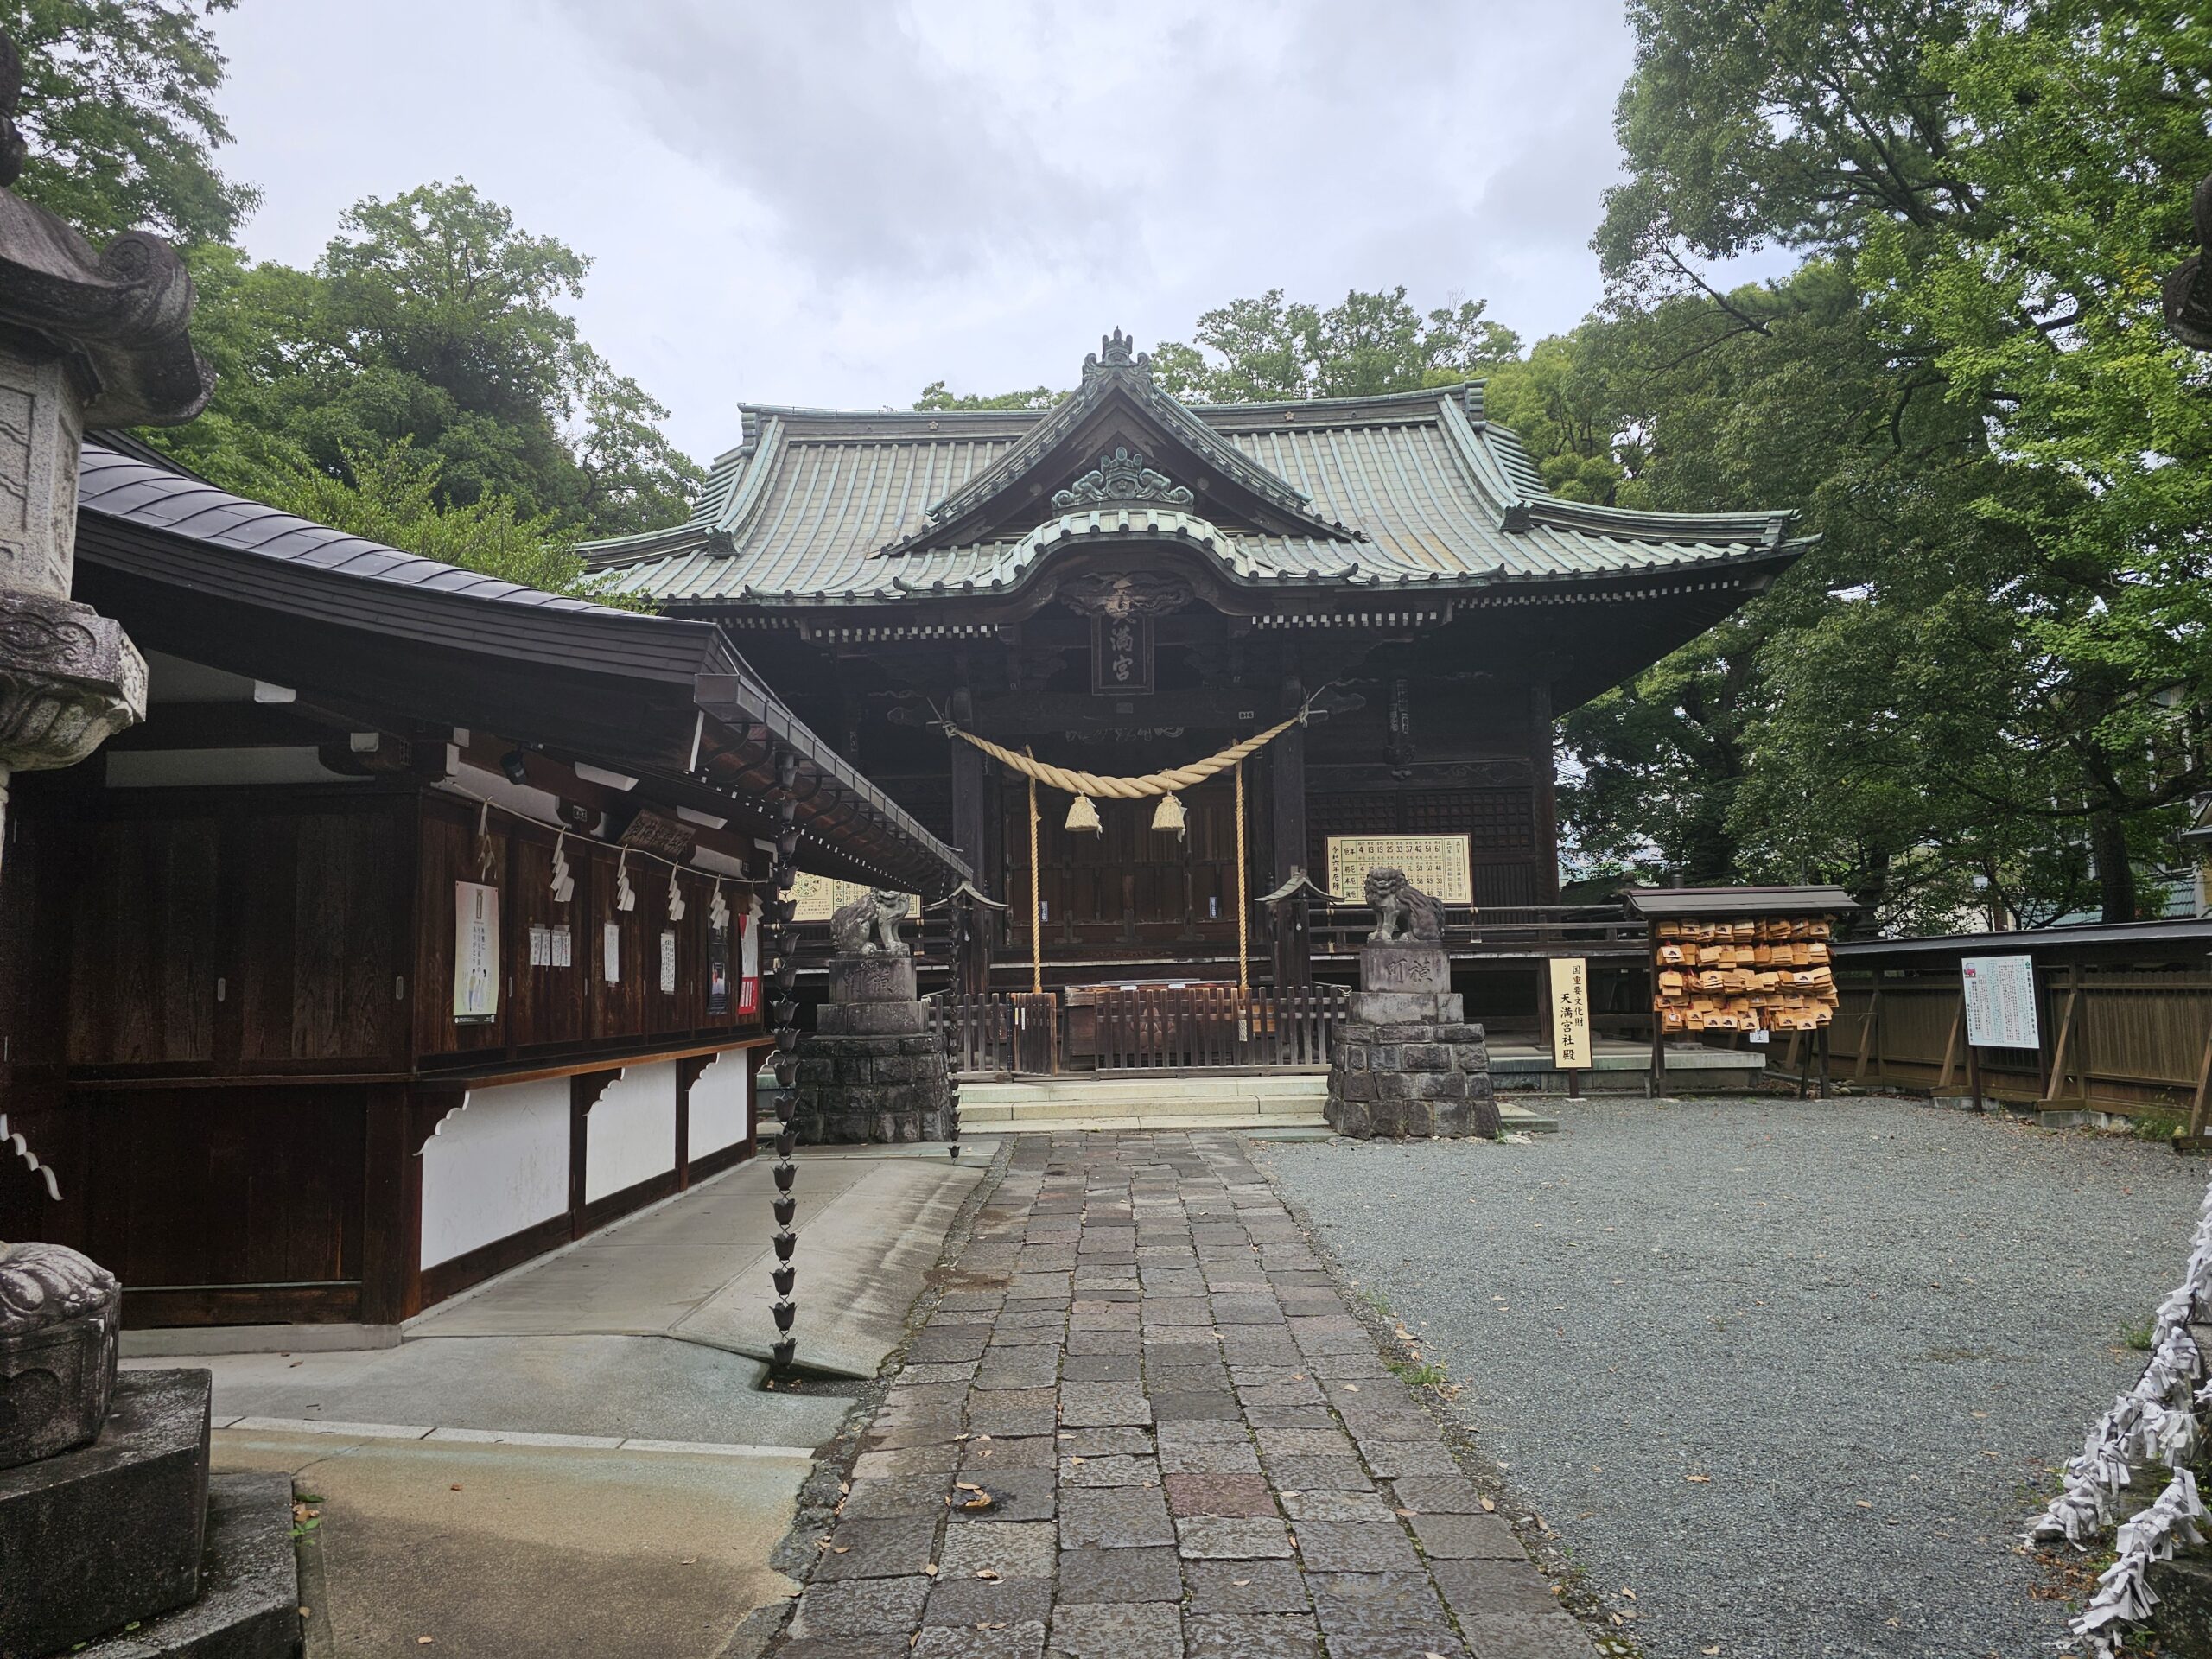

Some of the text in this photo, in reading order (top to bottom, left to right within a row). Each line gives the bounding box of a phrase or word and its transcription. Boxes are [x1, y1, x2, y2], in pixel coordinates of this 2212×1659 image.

[1110, 618, 1136, 681] 満宮
[1560, 993, 1576, 1061] 天満宮社殿
[1572, 965, 1584, 1027] 国重要文化財
